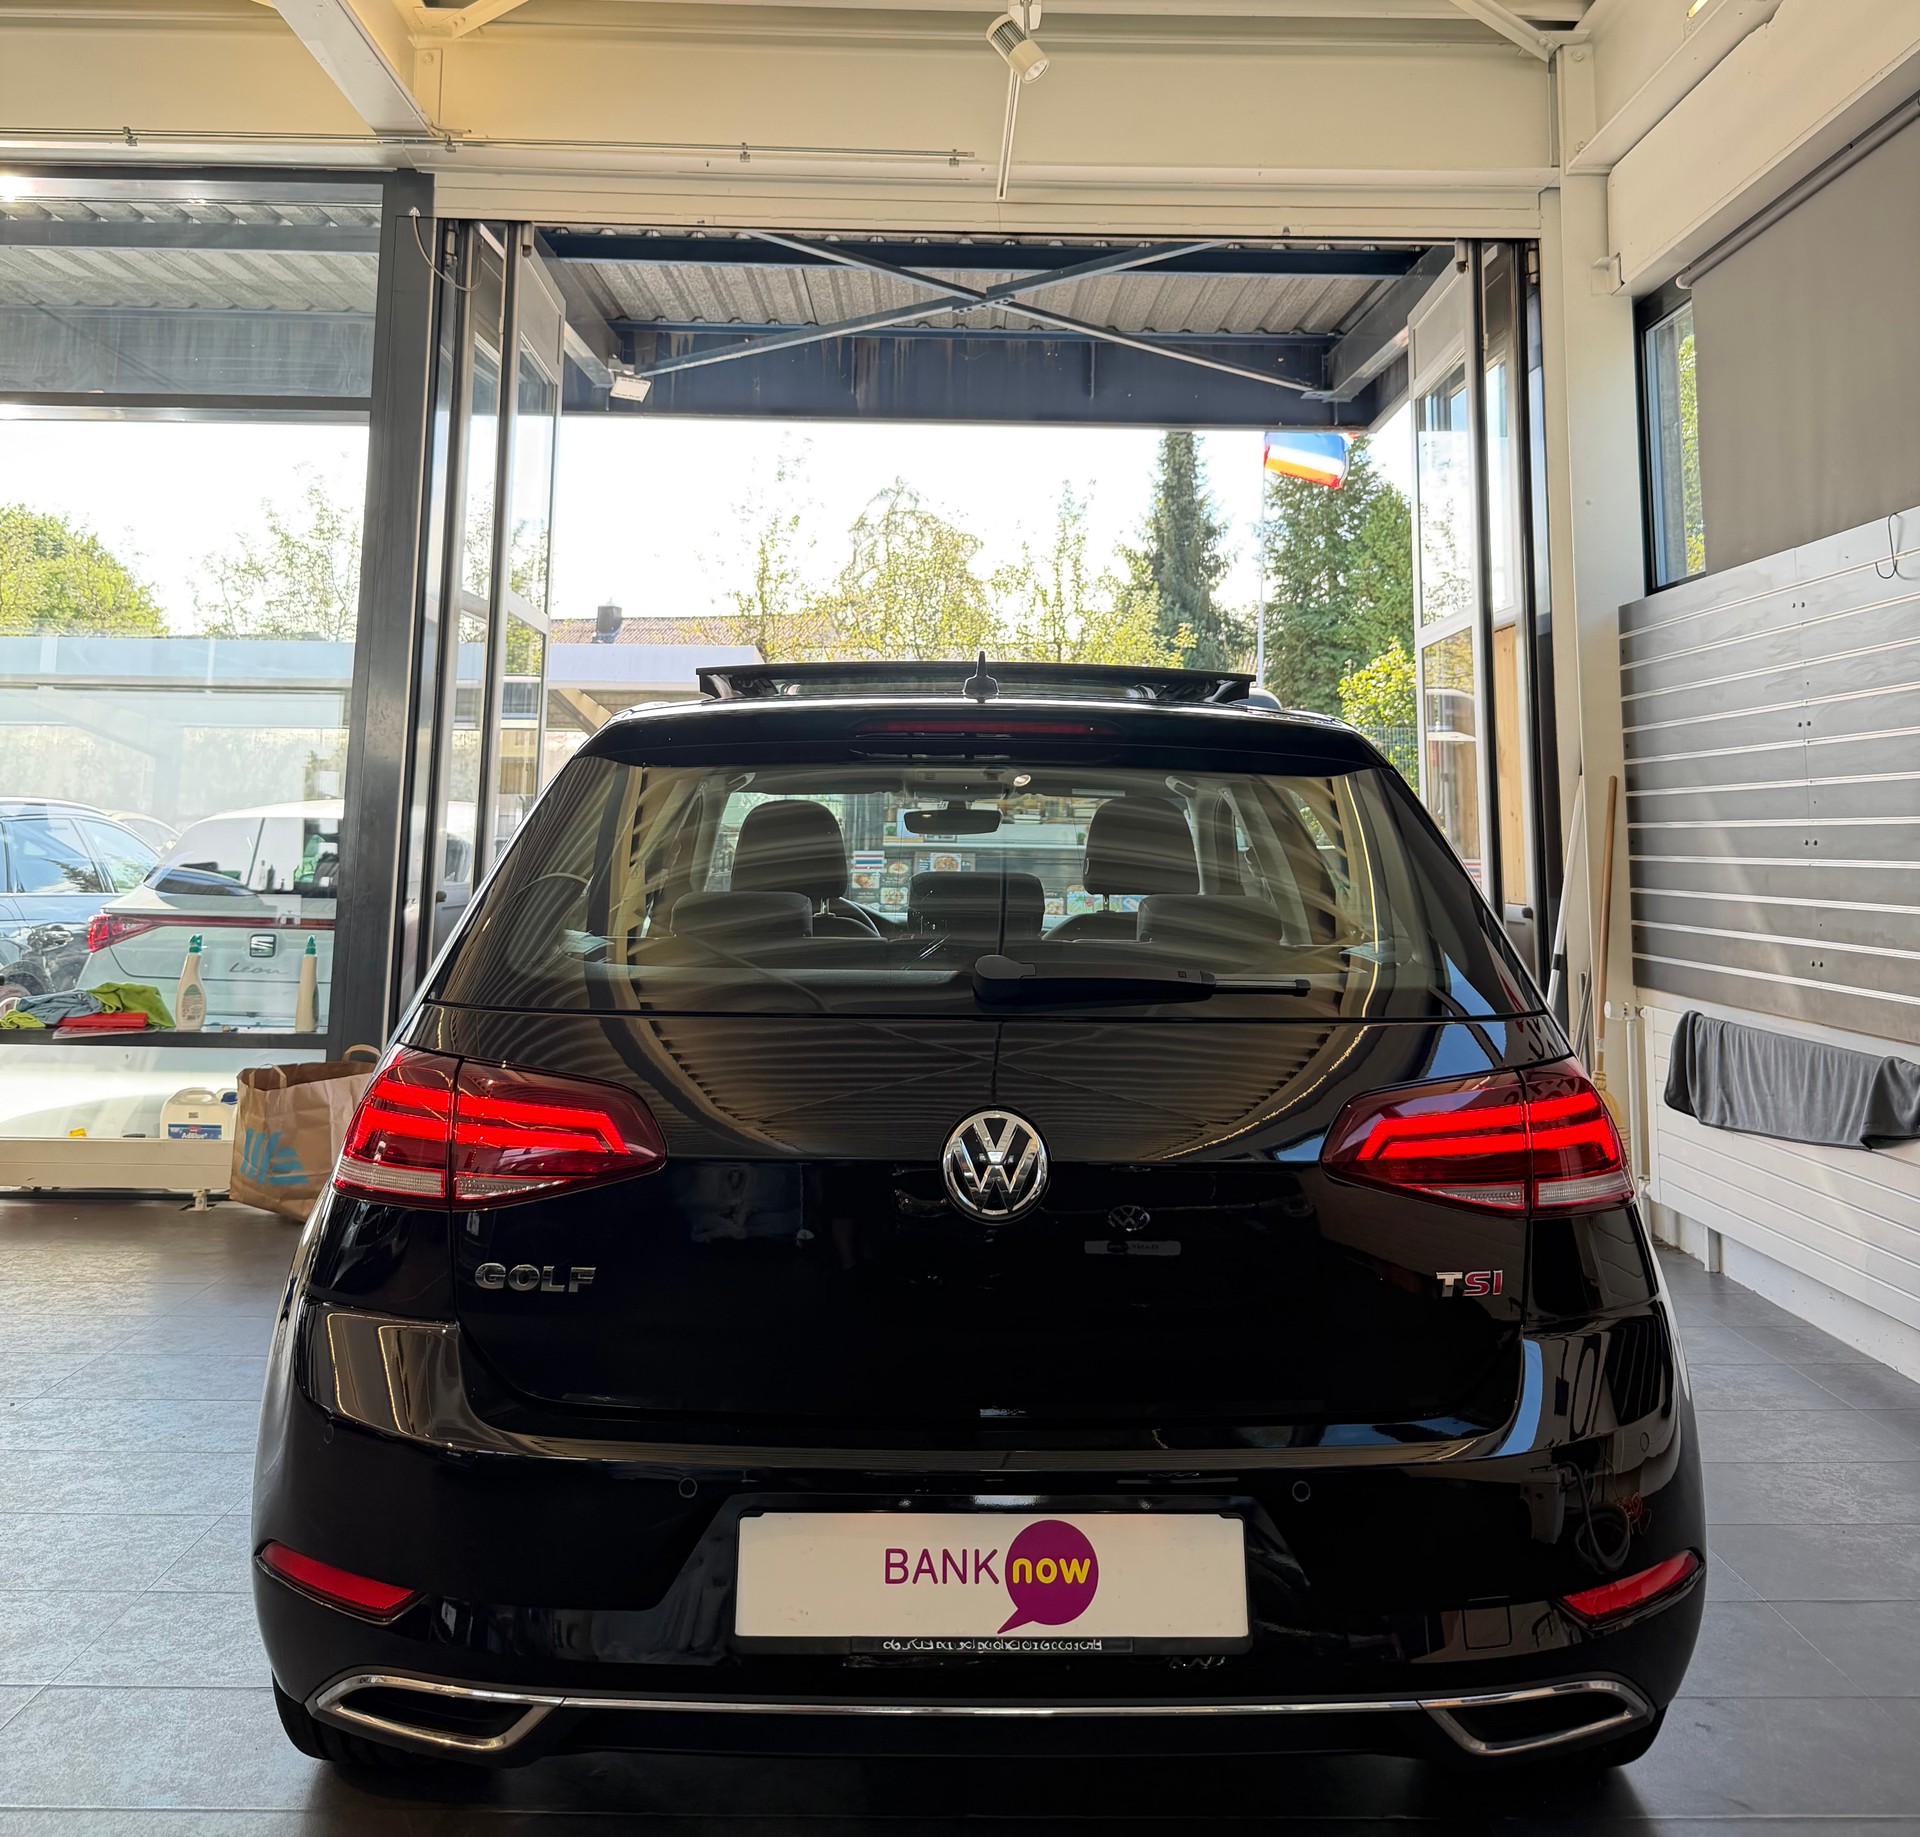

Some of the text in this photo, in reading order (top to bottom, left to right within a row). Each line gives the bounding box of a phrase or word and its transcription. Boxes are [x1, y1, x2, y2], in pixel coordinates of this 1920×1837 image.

[229, 962, 290, 975] Leon
[474, 1262, 597, 1293] GOLF
[1435, 1269, 1503, 1298] TSI
[884, 1548, 1091, 1585] BANK now
